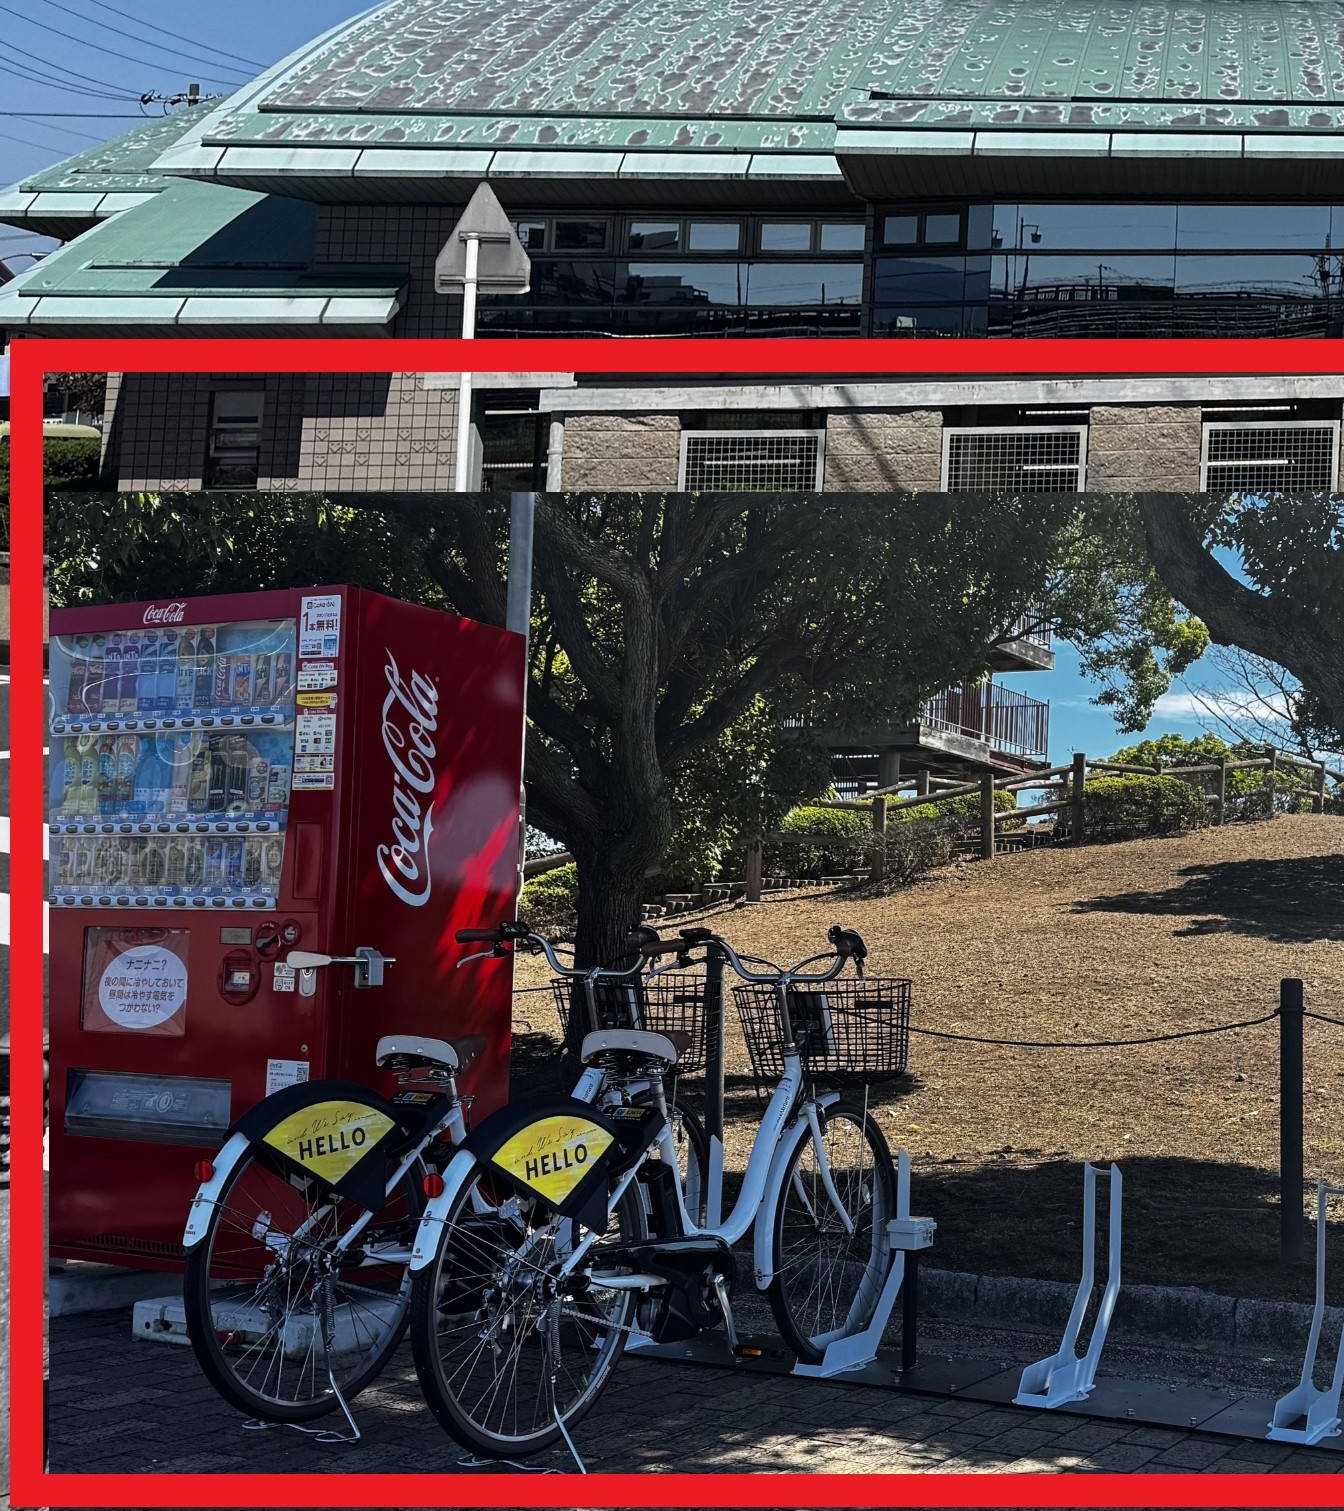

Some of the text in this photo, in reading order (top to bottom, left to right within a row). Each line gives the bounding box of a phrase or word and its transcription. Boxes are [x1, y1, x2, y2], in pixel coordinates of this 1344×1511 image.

[377, 647, 439, 907] Coca-Cola
[299, 1127, 366, 1161] HELLO
[525, 1143, 588, 1181] HELLO
